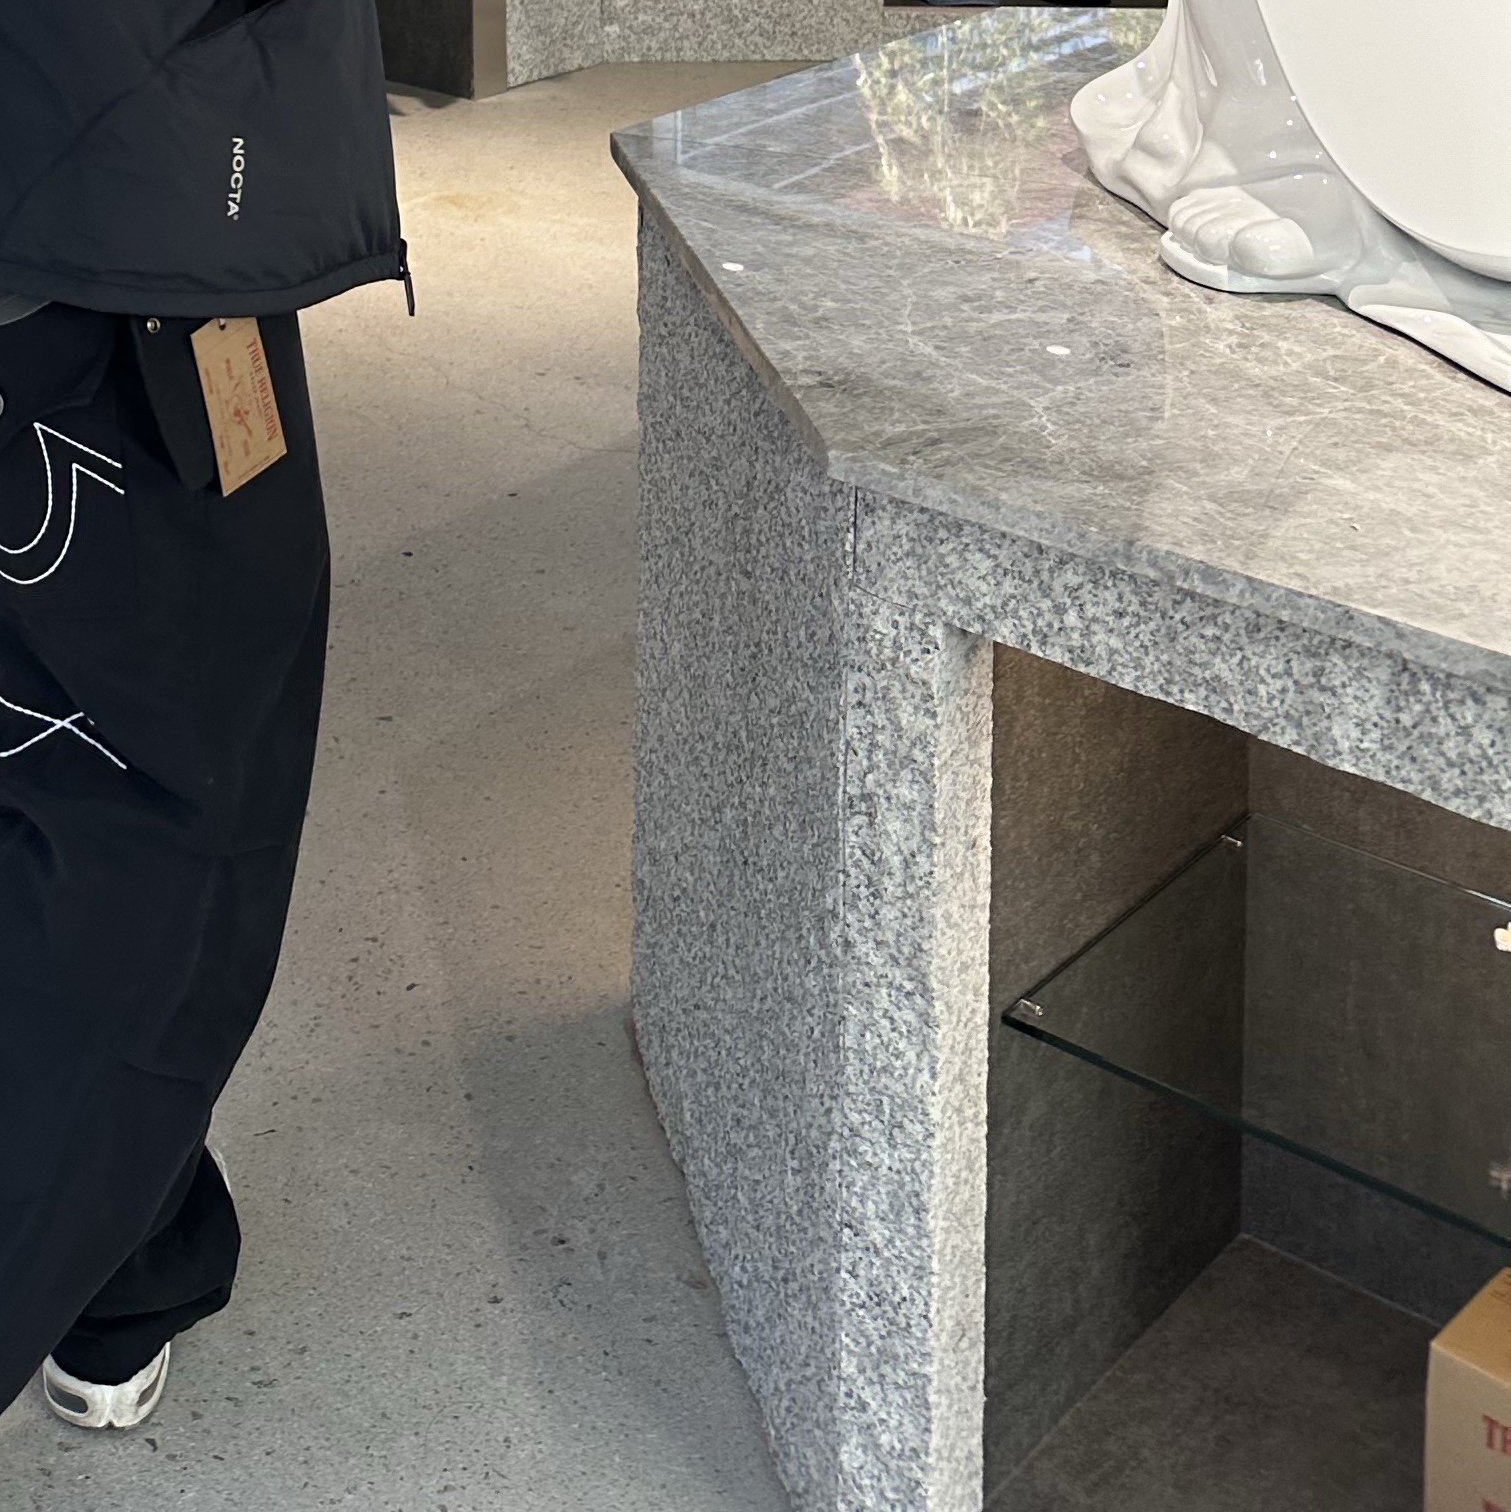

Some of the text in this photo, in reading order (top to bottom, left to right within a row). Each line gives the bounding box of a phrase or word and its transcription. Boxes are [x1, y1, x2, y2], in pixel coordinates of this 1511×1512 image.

[227, 137, 245, 218] NOCTA
[246, 337, 264, 377] TRUE
[257, 376, 279, 442] RELIGION
